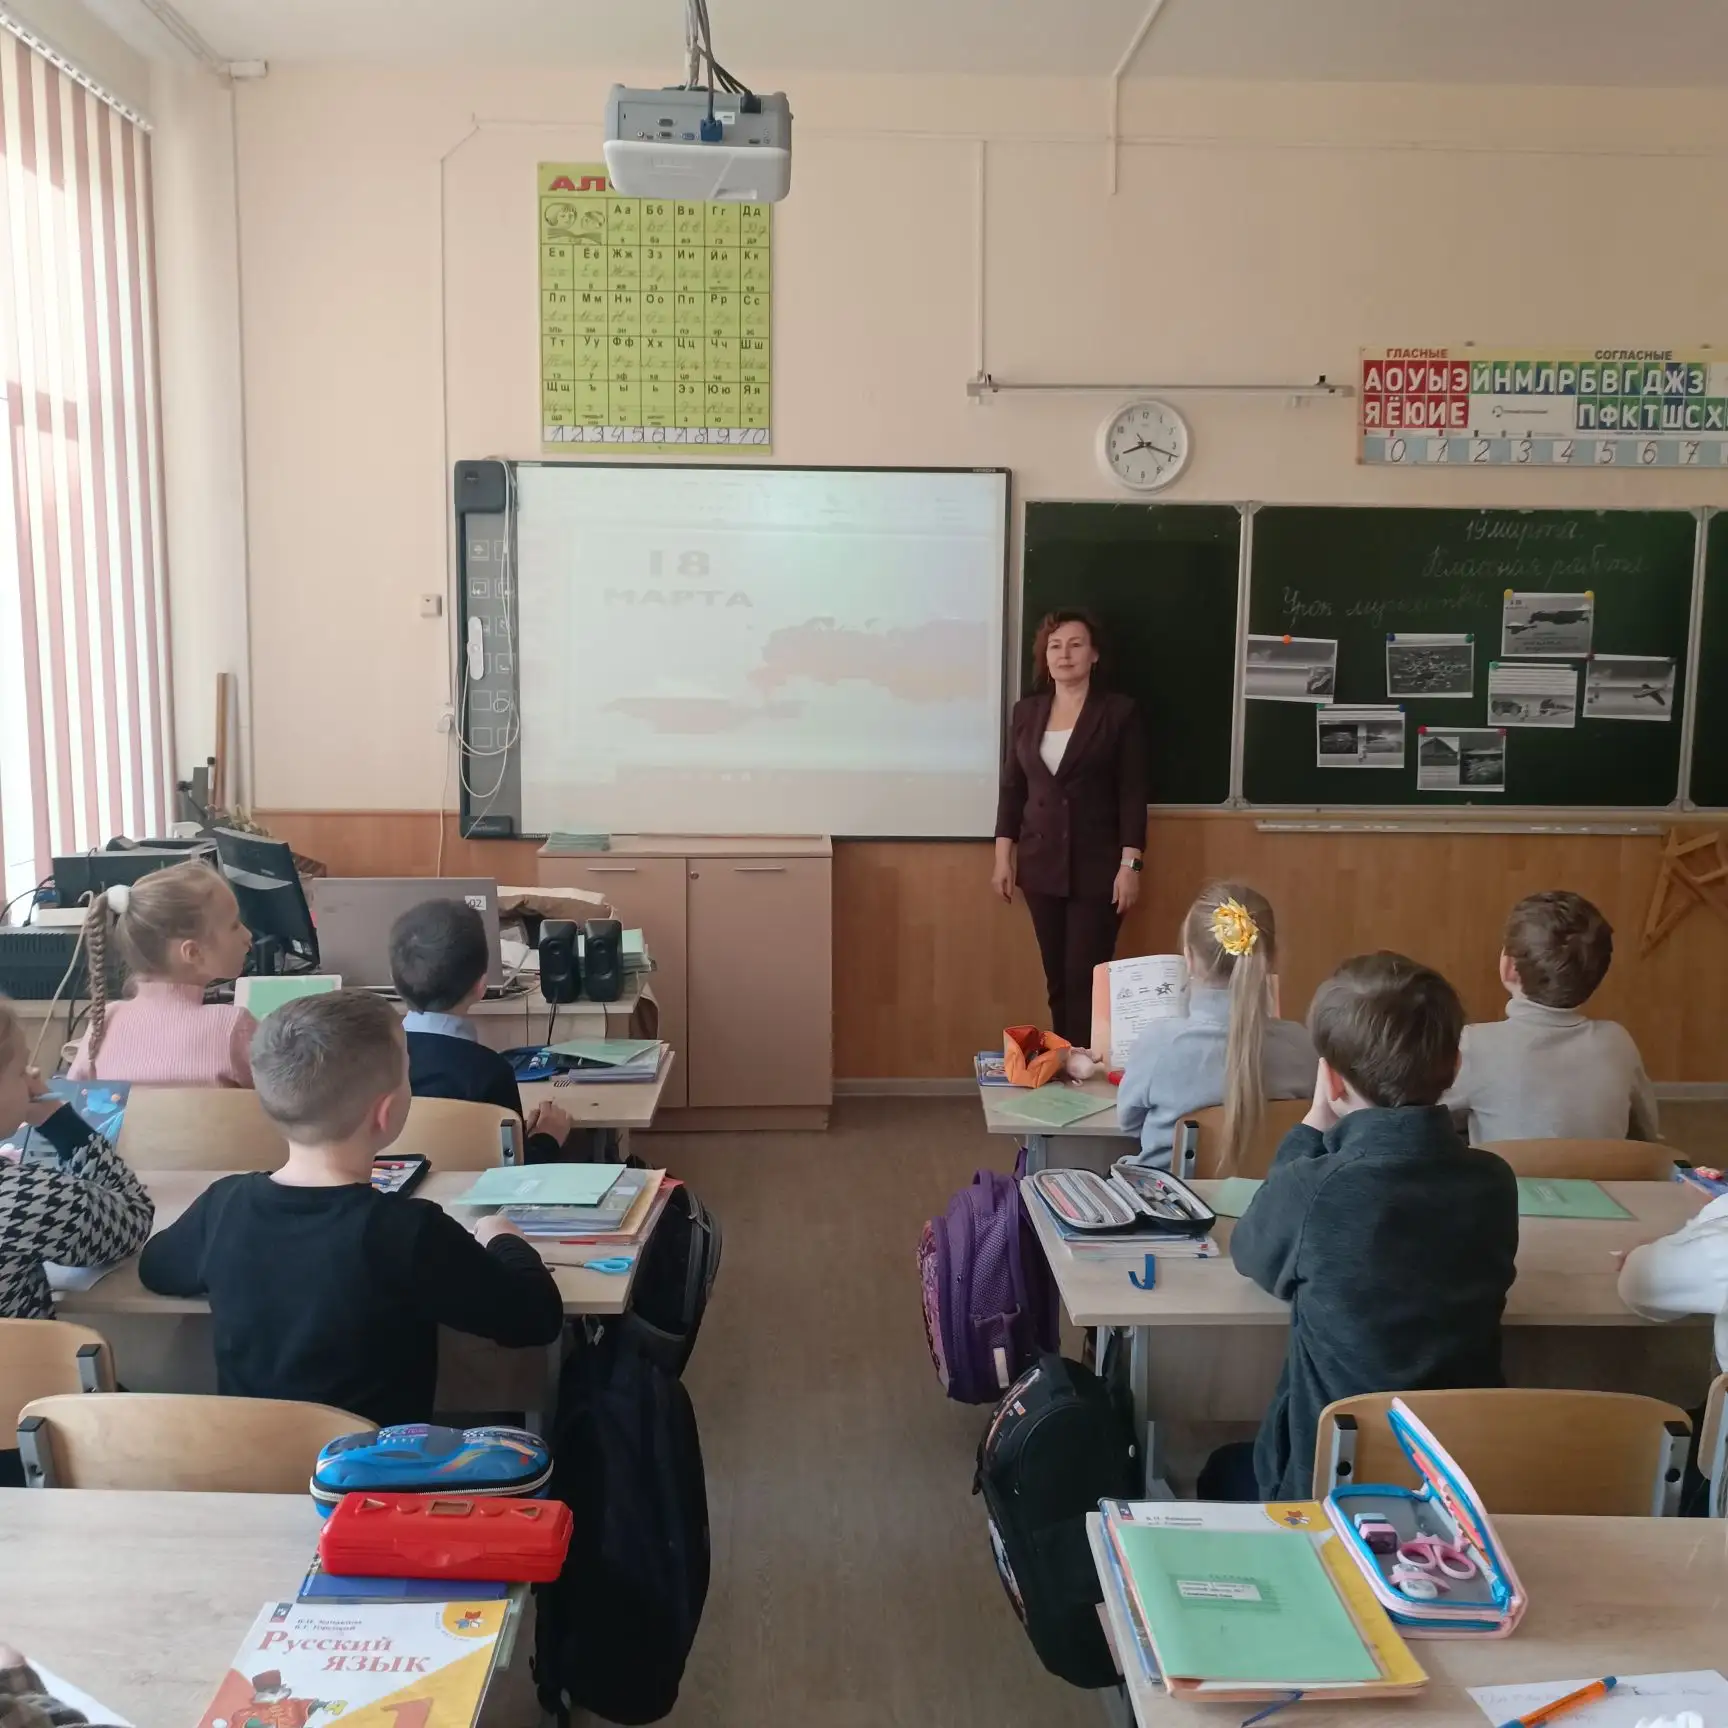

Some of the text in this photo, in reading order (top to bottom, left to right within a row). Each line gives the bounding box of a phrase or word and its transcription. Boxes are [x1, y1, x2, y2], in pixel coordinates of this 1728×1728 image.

[548, 175, 615, 191] АЛ
[1386, 348, 1449, 359] ГЛАСНЫЕ
[1594, 349, 1673, 361] СОГЛАСНЫЕ
[1472, 439, 1492, 463] 2
[1518, 440, 1535, 463] 3
[1559, 439, 1576, 460] 4
[1601, 440, 1618, 464] 5
[1642, 440, 1657, 465] 6
[1684, 440, 1700, 465] 7
[648, 550, 711, 577] 18
[603, 587, 754, 608] МАРТА
[257, 1629, 395, 1656] Русский
